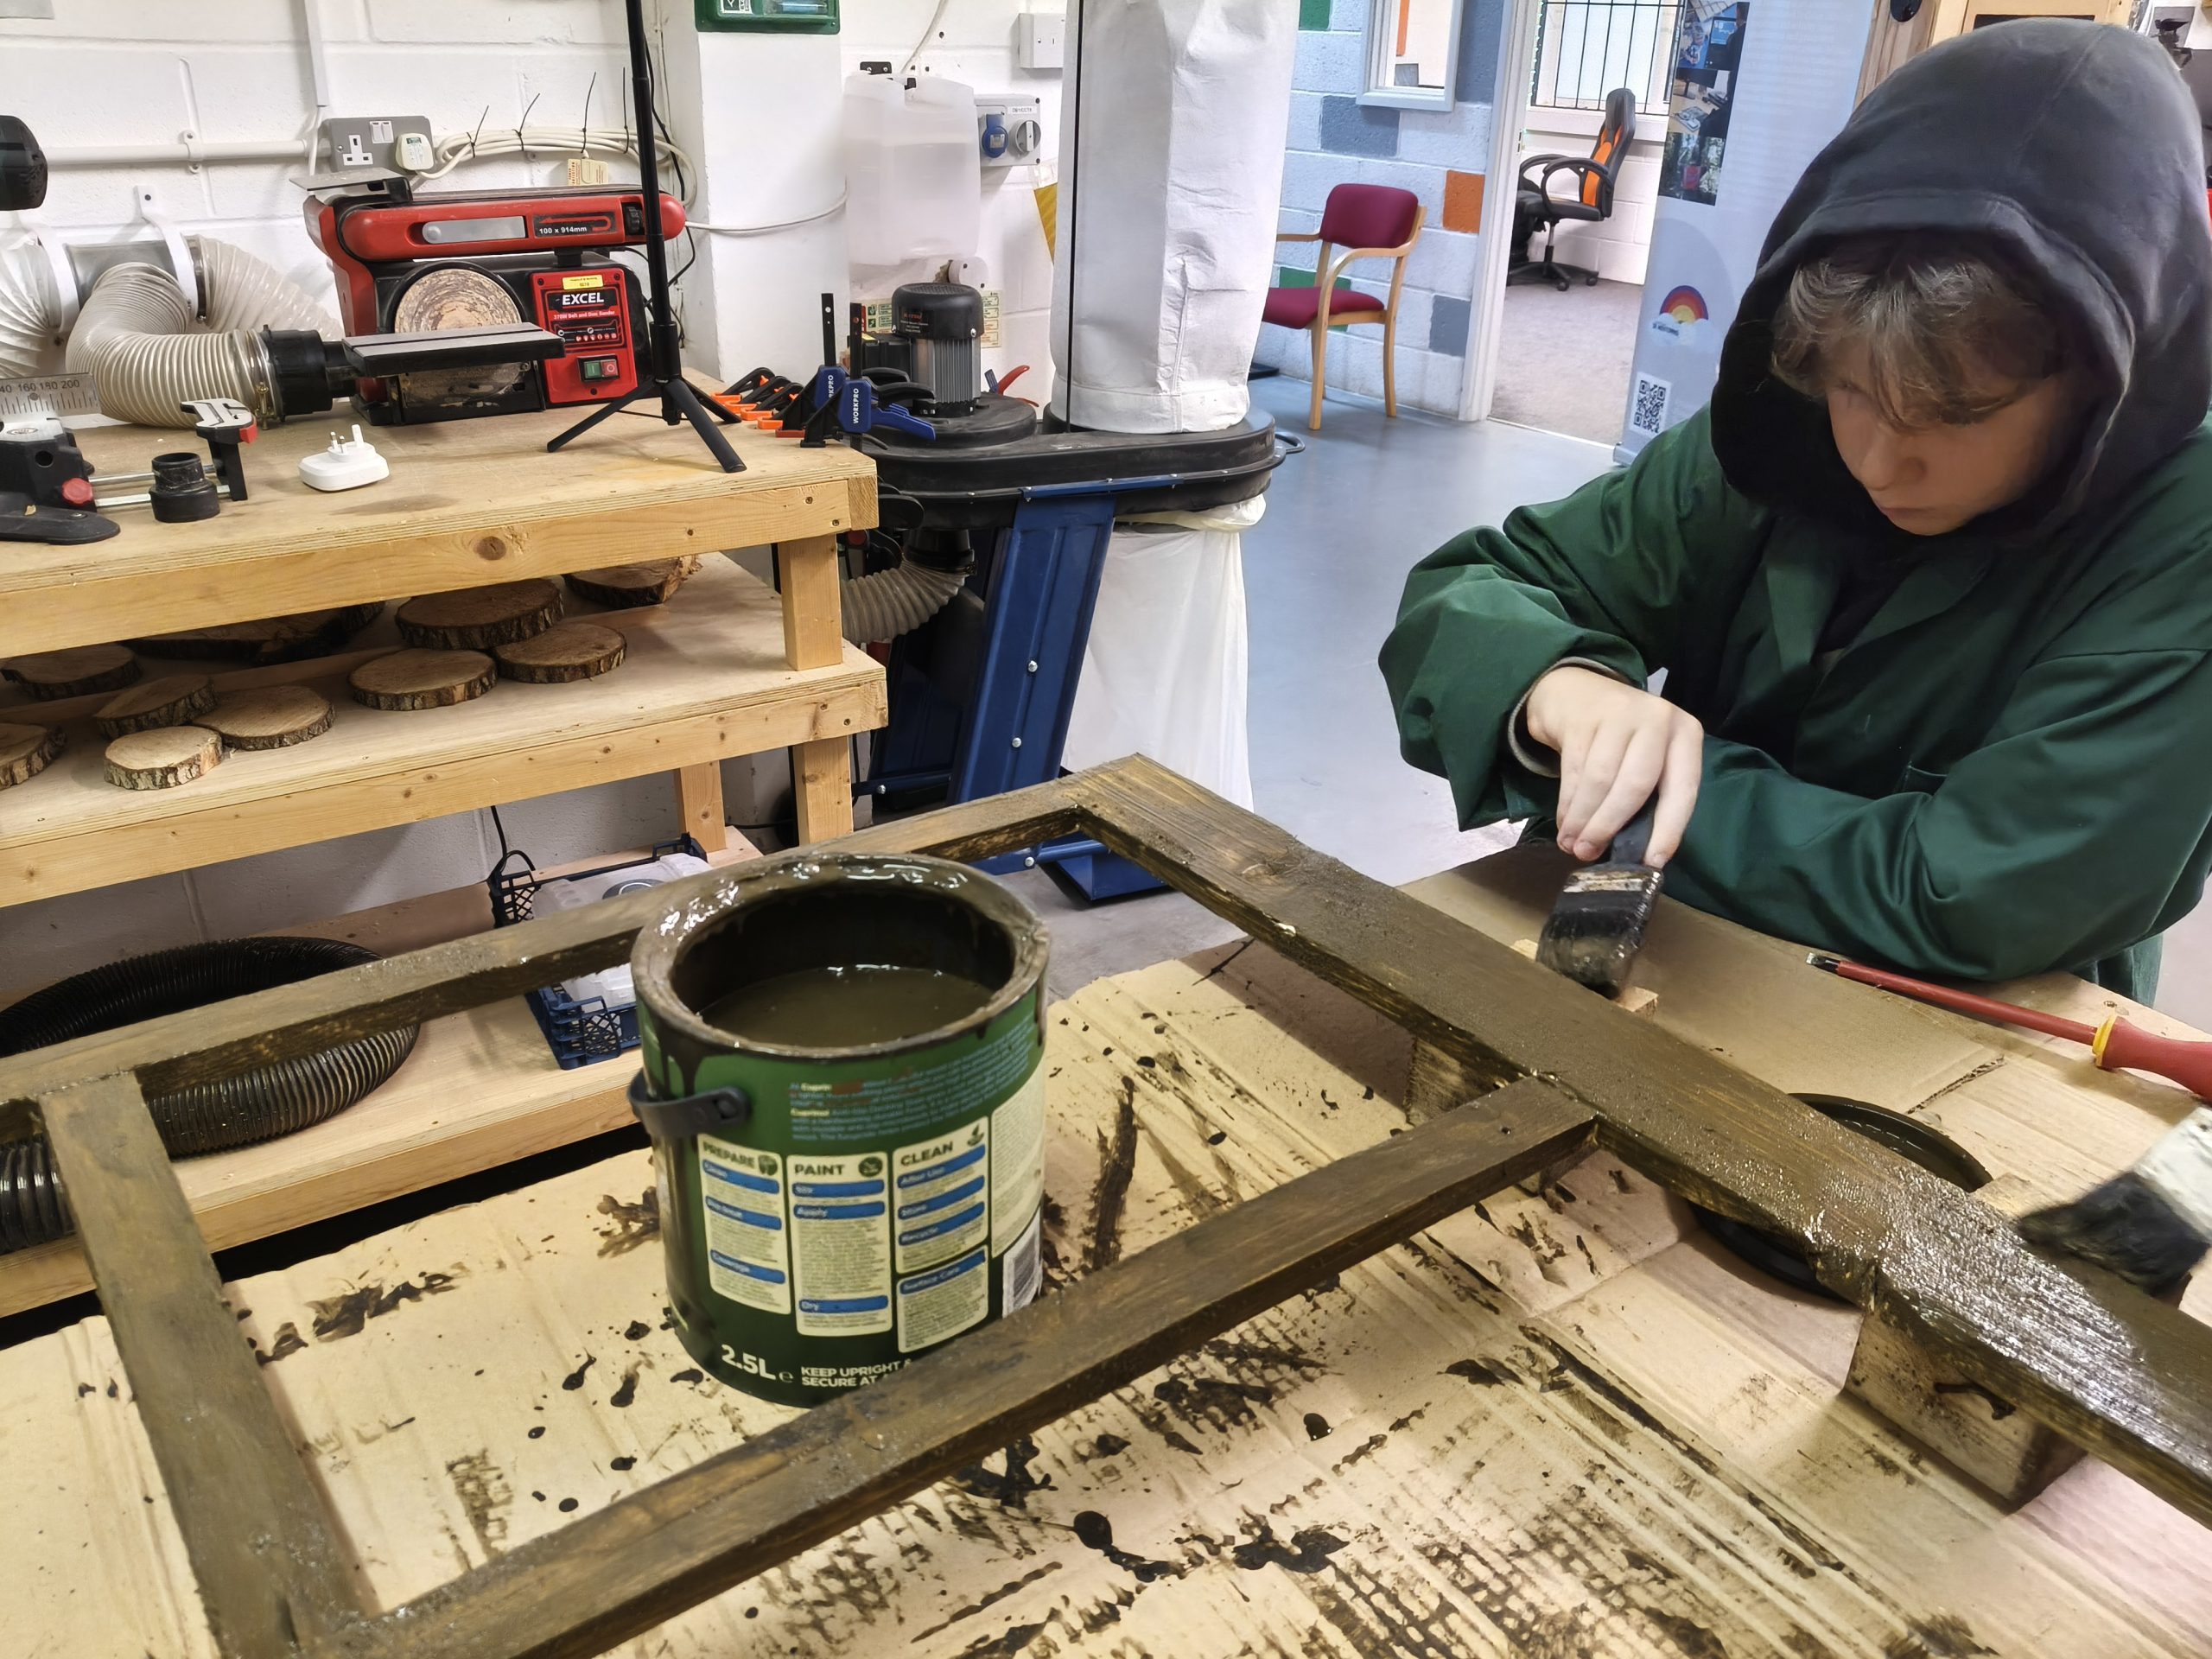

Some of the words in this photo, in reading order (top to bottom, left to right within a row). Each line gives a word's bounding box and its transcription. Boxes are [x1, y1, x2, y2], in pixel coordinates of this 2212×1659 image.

[563, 292, 604, 305] EXCEL
[18, 383, 35, 391] 160
[60, 379, 79, 388] 200
[702, 1141, 755, 1169] PREPARE
[900, 1141, 953, 1166] CLEAN
[794, 1164, 845, 1175] PAINT
[721, 1344, 776, 1380] 2.5L
[801, 1366, 836, 1378] KEEP
[840, 1361, 901, 1377] UPRIGHT
[802, 1376, 856, 1388] SECURE
